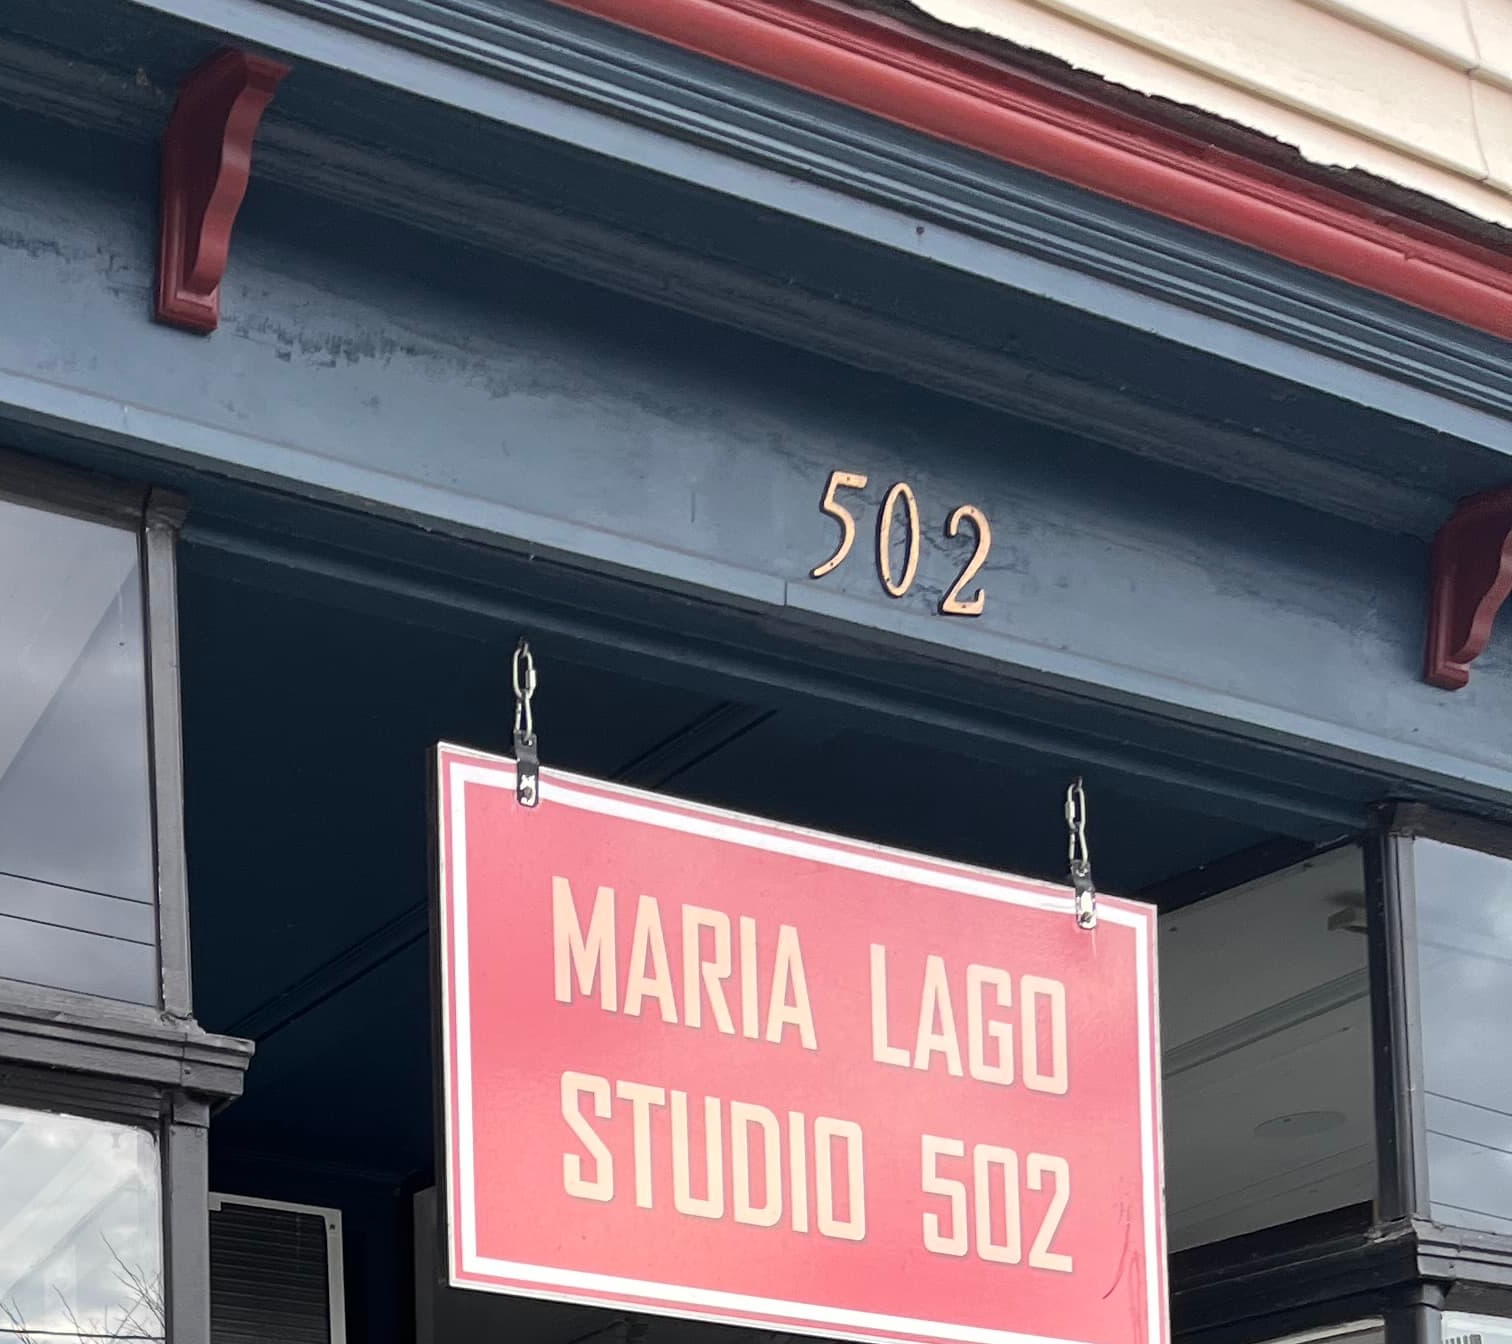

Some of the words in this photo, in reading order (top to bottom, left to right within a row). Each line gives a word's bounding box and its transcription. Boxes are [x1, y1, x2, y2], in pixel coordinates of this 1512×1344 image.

[809, 470, 991, 617] 502
[551, 875, 819, 1052] MARIA
[869, 942, 1069, 1096] LAGO
[560, 1070, 867, 1242] STUDIO
[921, 1133, 1074, 1274] 502
